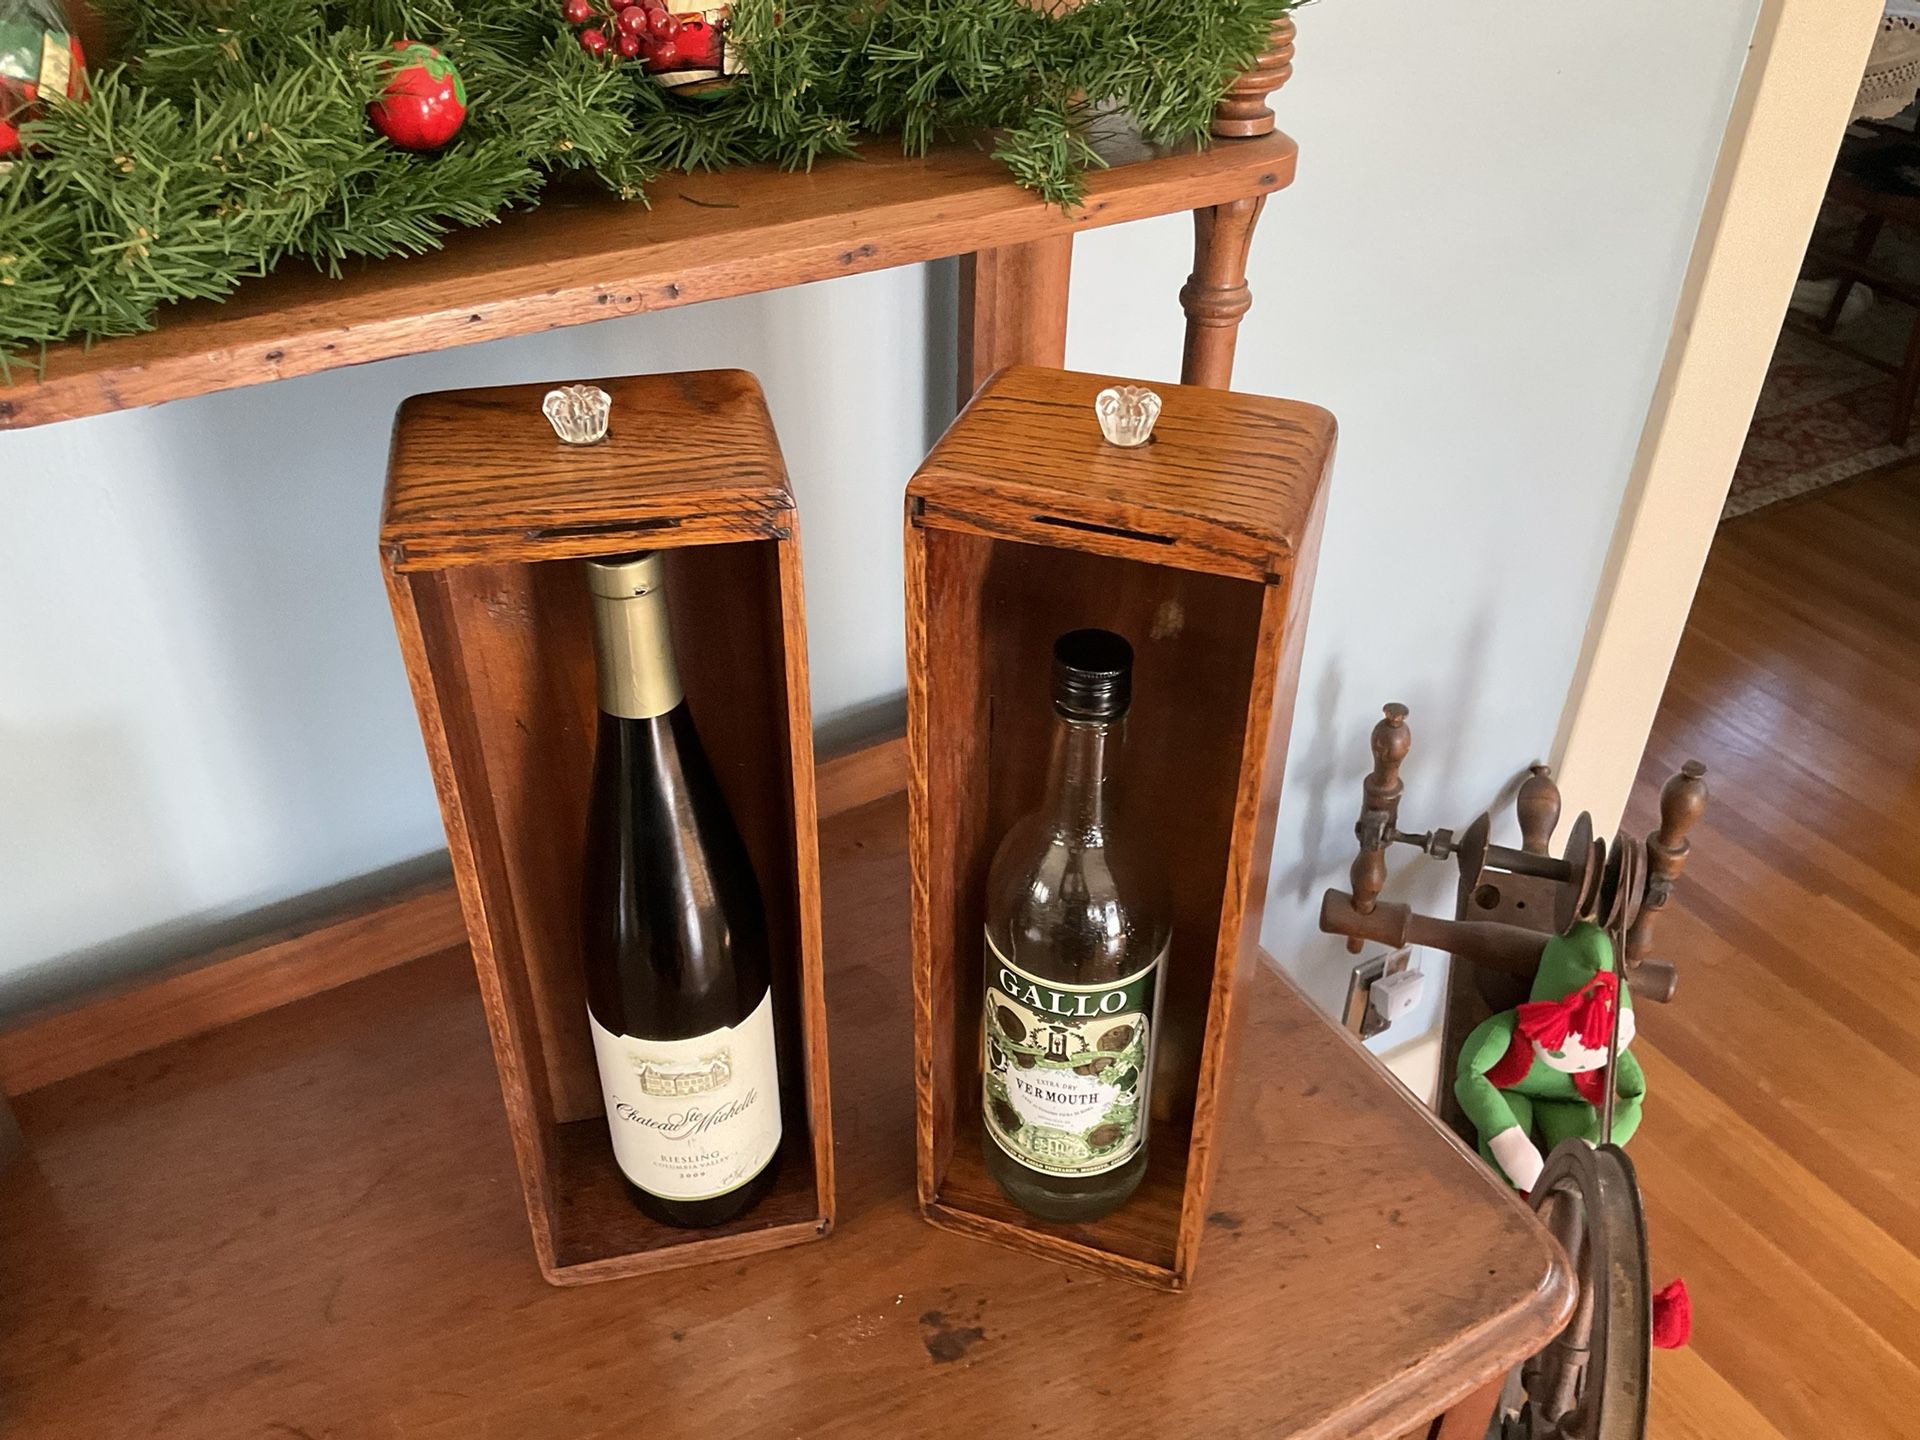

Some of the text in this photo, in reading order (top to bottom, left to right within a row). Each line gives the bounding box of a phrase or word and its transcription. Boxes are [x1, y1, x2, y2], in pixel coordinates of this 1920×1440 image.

[1000, 968, 1128, 1017] GALLO
[1015, 1077, 1099, 1105] VERMOUTH
[1036, 1078, 1078, 1091] EXTRA DRY
[612, 1087, 758, 1137] Chateau Ste Michelle
[660, 1150, 720, 1164] RIESLING
